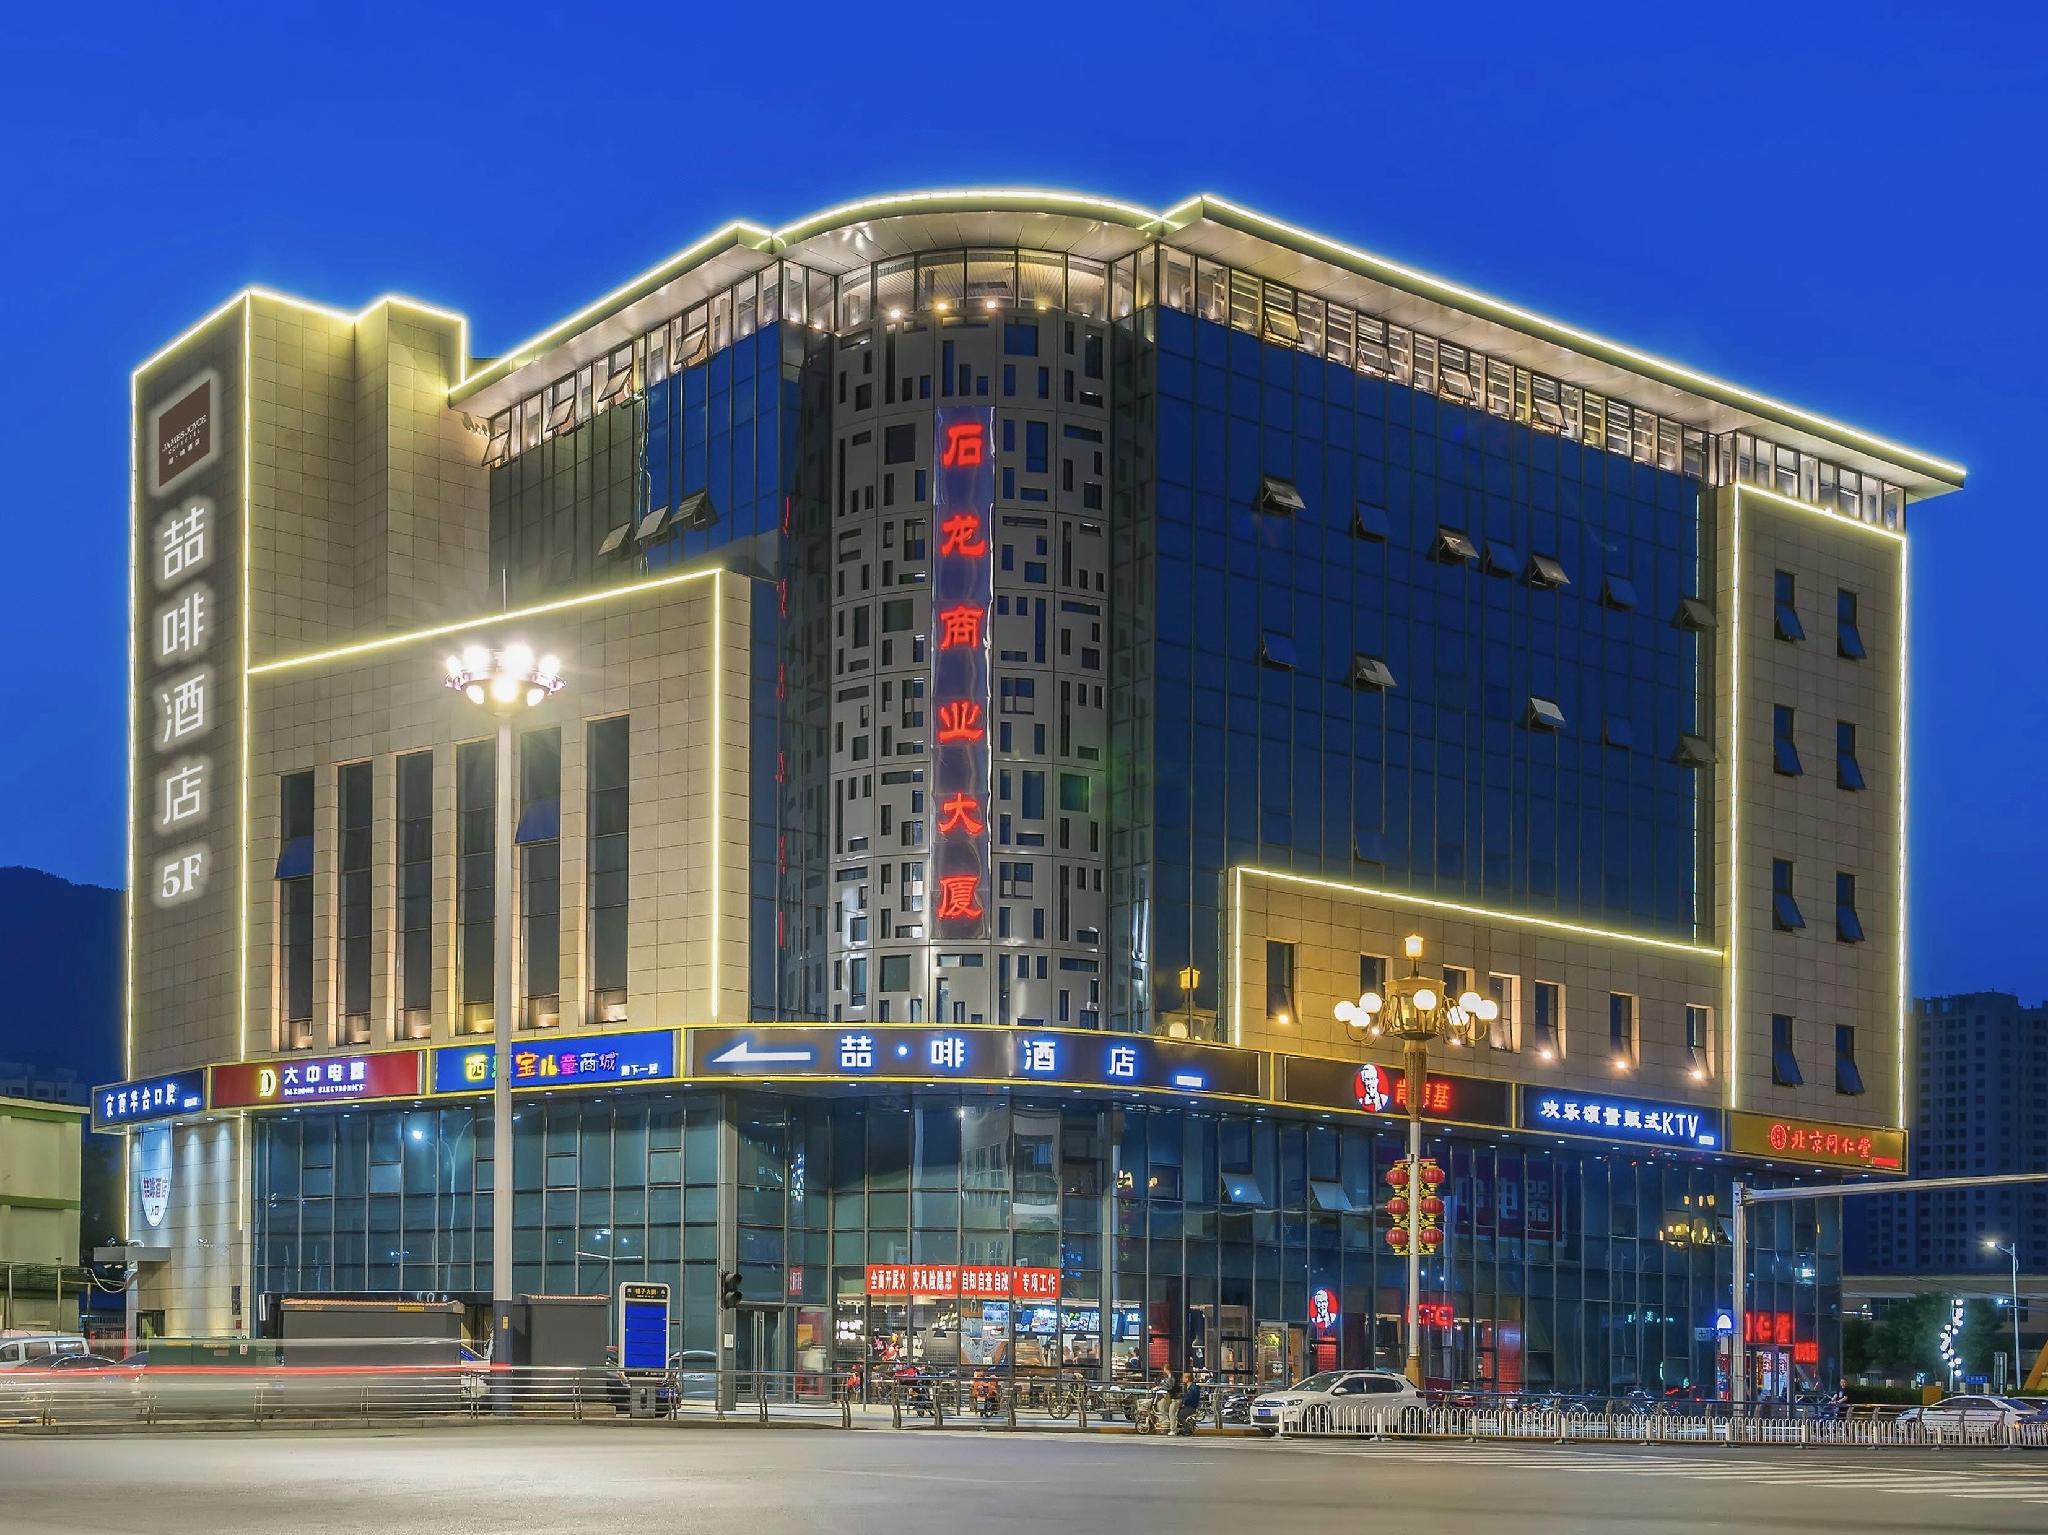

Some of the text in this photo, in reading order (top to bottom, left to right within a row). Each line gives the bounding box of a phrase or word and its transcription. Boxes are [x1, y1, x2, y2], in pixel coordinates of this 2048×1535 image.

[162, 506, 205, 825] 喆啡酒店
[938, 422, 985, 918] 石龙商业大厦
[161, 852, 203, 899] 5F
[284, 1061, 366, 1085] 大中电器
[464, 1051, 618, 1081] 西宝儿童商城
[1396, 1079, 1451, 1109] 肯基
[1791, 1129, 1872, 1158] 北京同仁堂
